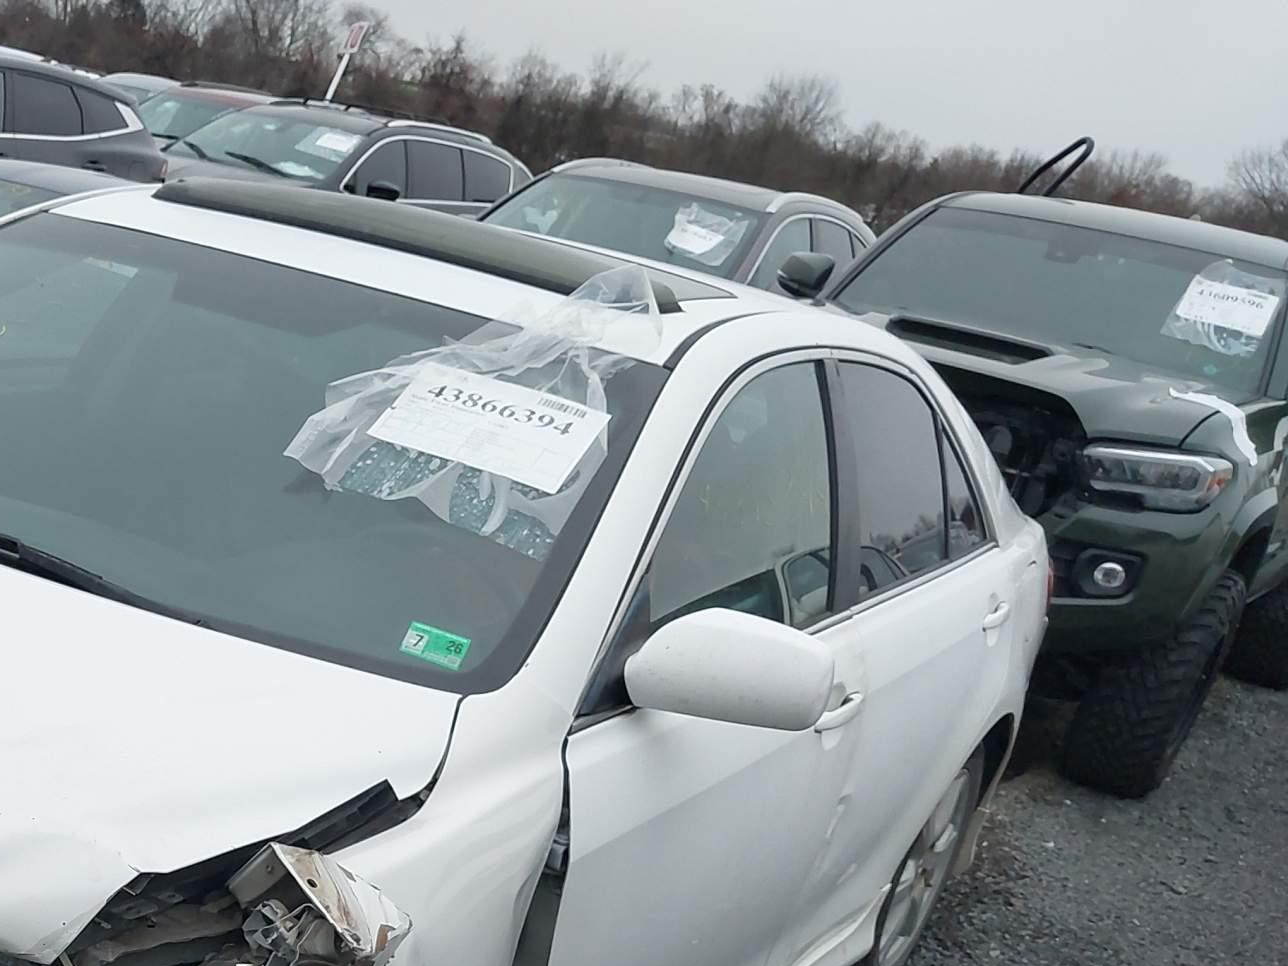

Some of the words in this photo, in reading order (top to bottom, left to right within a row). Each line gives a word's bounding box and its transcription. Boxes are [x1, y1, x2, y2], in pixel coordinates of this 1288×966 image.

[427, 385, 574, 435] 43866394
[413, 633, 424, 647] 7
[446, 641, 464, 654] 26
